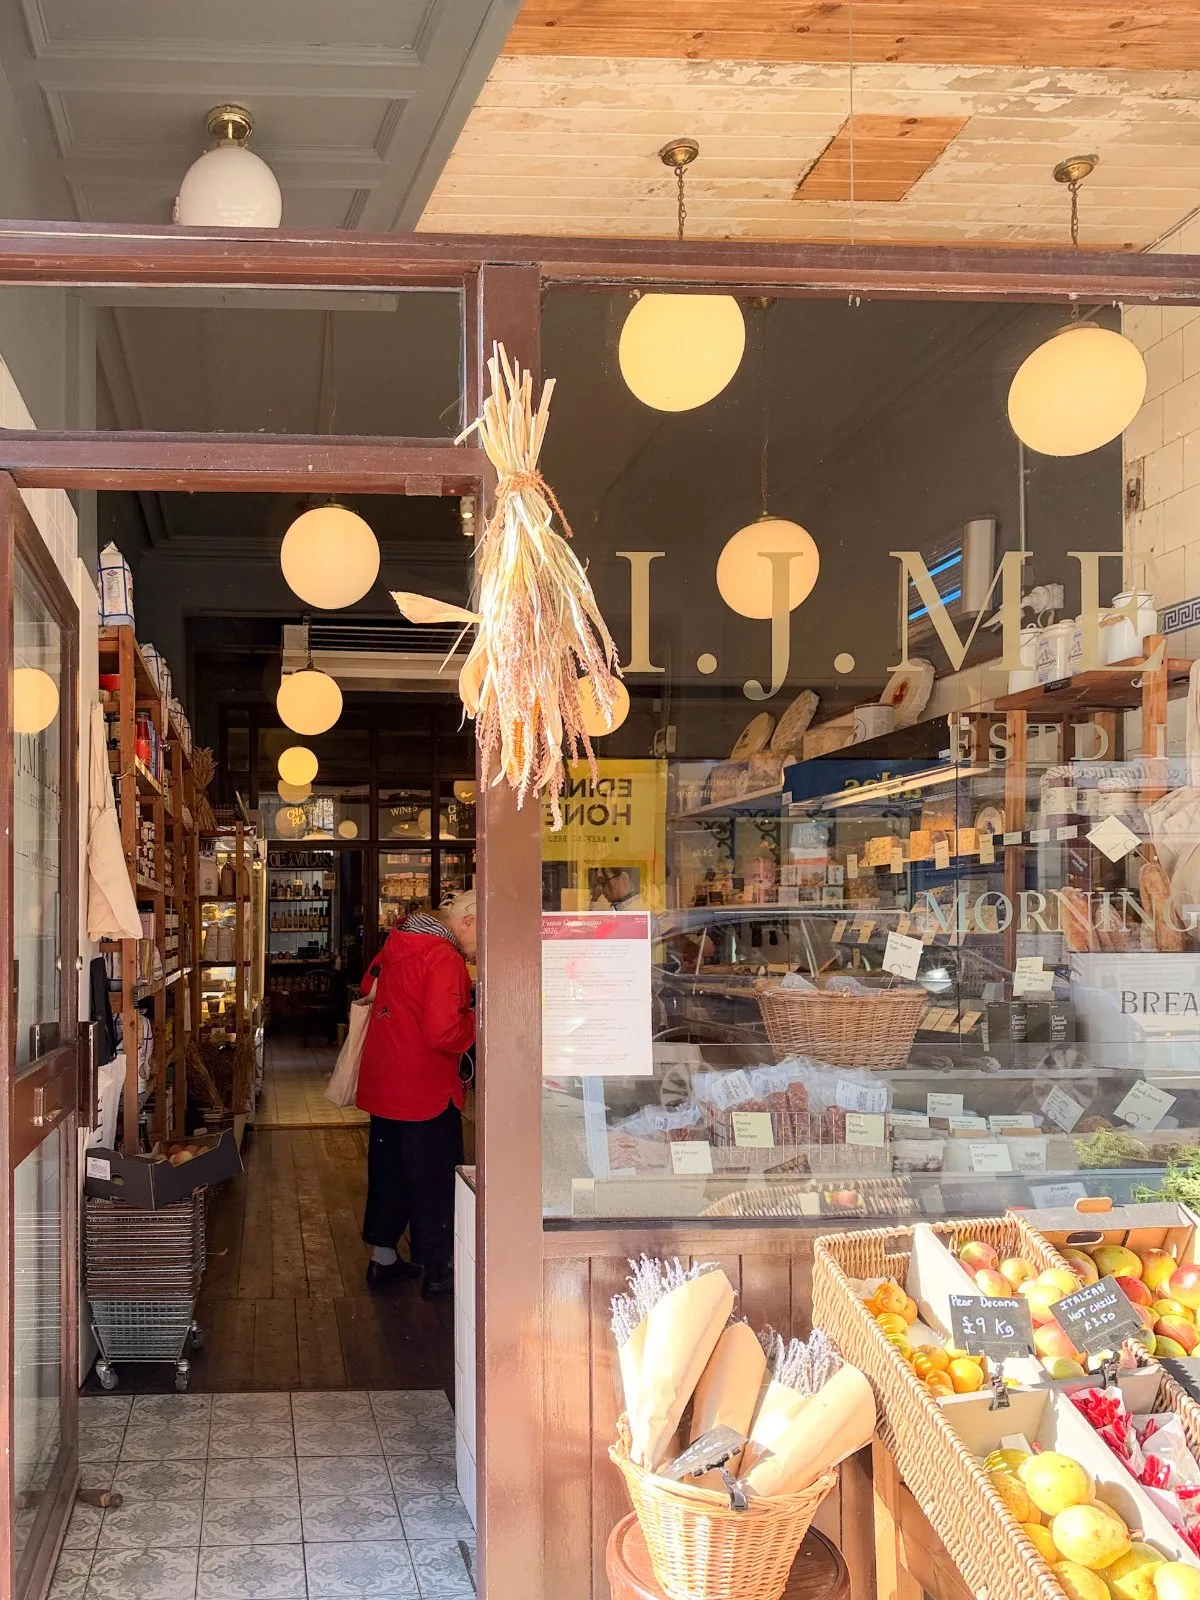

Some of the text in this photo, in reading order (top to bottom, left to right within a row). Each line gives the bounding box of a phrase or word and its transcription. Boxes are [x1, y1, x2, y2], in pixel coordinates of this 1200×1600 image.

[391, 805, 418, 817] WINES
[922, 891, 1200, 933] MORNING
[1120, 990, 1200, 1017] BREA
[951, 1295, 973, 1307] Pear
[1060, 1283, 1106, 1310] ITALIAN
[1068, 1307, 1086, 1322] HOT
[1084, 1312, 1116, 1331] £3.50
[962, 1315, 986, 1335] £9
